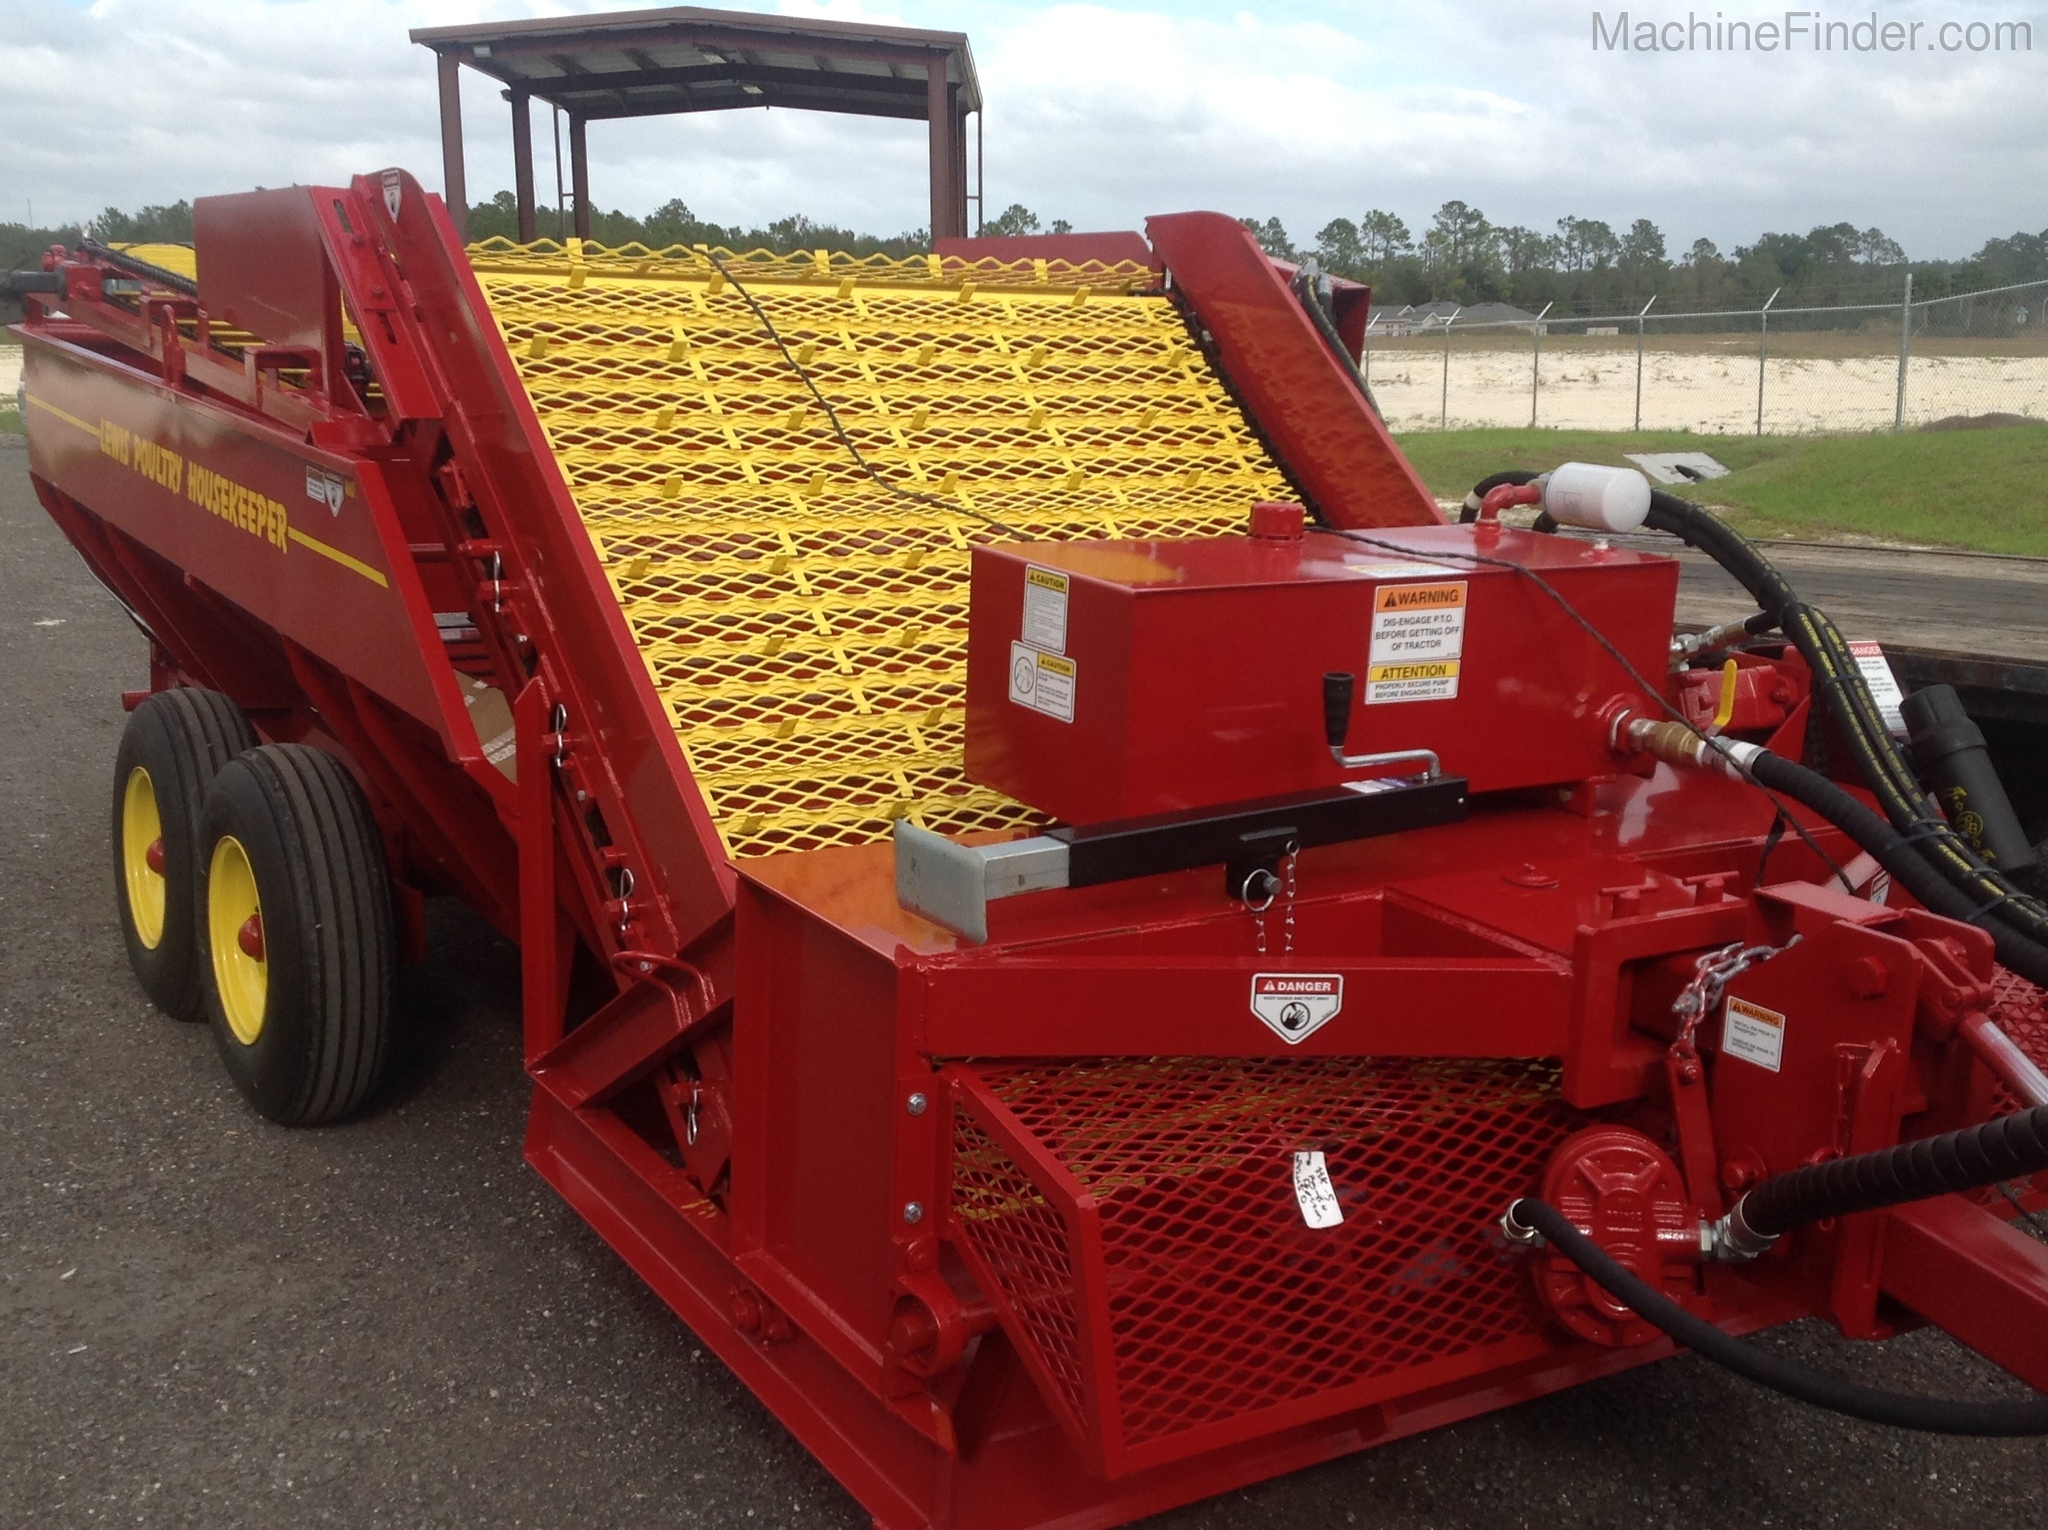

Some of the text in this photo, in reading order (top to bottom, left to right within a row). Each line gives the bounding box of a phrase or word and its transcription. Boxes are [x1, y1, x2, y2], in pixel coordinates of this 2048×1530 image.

[133, 433, 183, 495] POULTRY
[187, 460, 288, 554] HOUSEKEEPER
[1036, 573, 1065, 590] CAUTION
[1398, 589, 1459, 605] WARNING
[1383, 616, 1432, 627] DIS-ENGAGE
[1375, 626, 1460, 640] BEFORE GETTING OFF
[1391, 640, 1441, 651] OF TRACTOR
[1046, 659, 1070, 673] CAUTION
[1381, 664, 1447, 679] ATTENTION
[1375, 681, 1406, 690] PROPERLY
[1407, 680, 1431, 688] SECURE
[1375, 690, 1400, 698] BEFORE
[1401, 688, 1431, 697] ENGAGING
[1277, 981, 1332, 992] DANGER
[1741, 1005, 1780, 1025] WARNING
